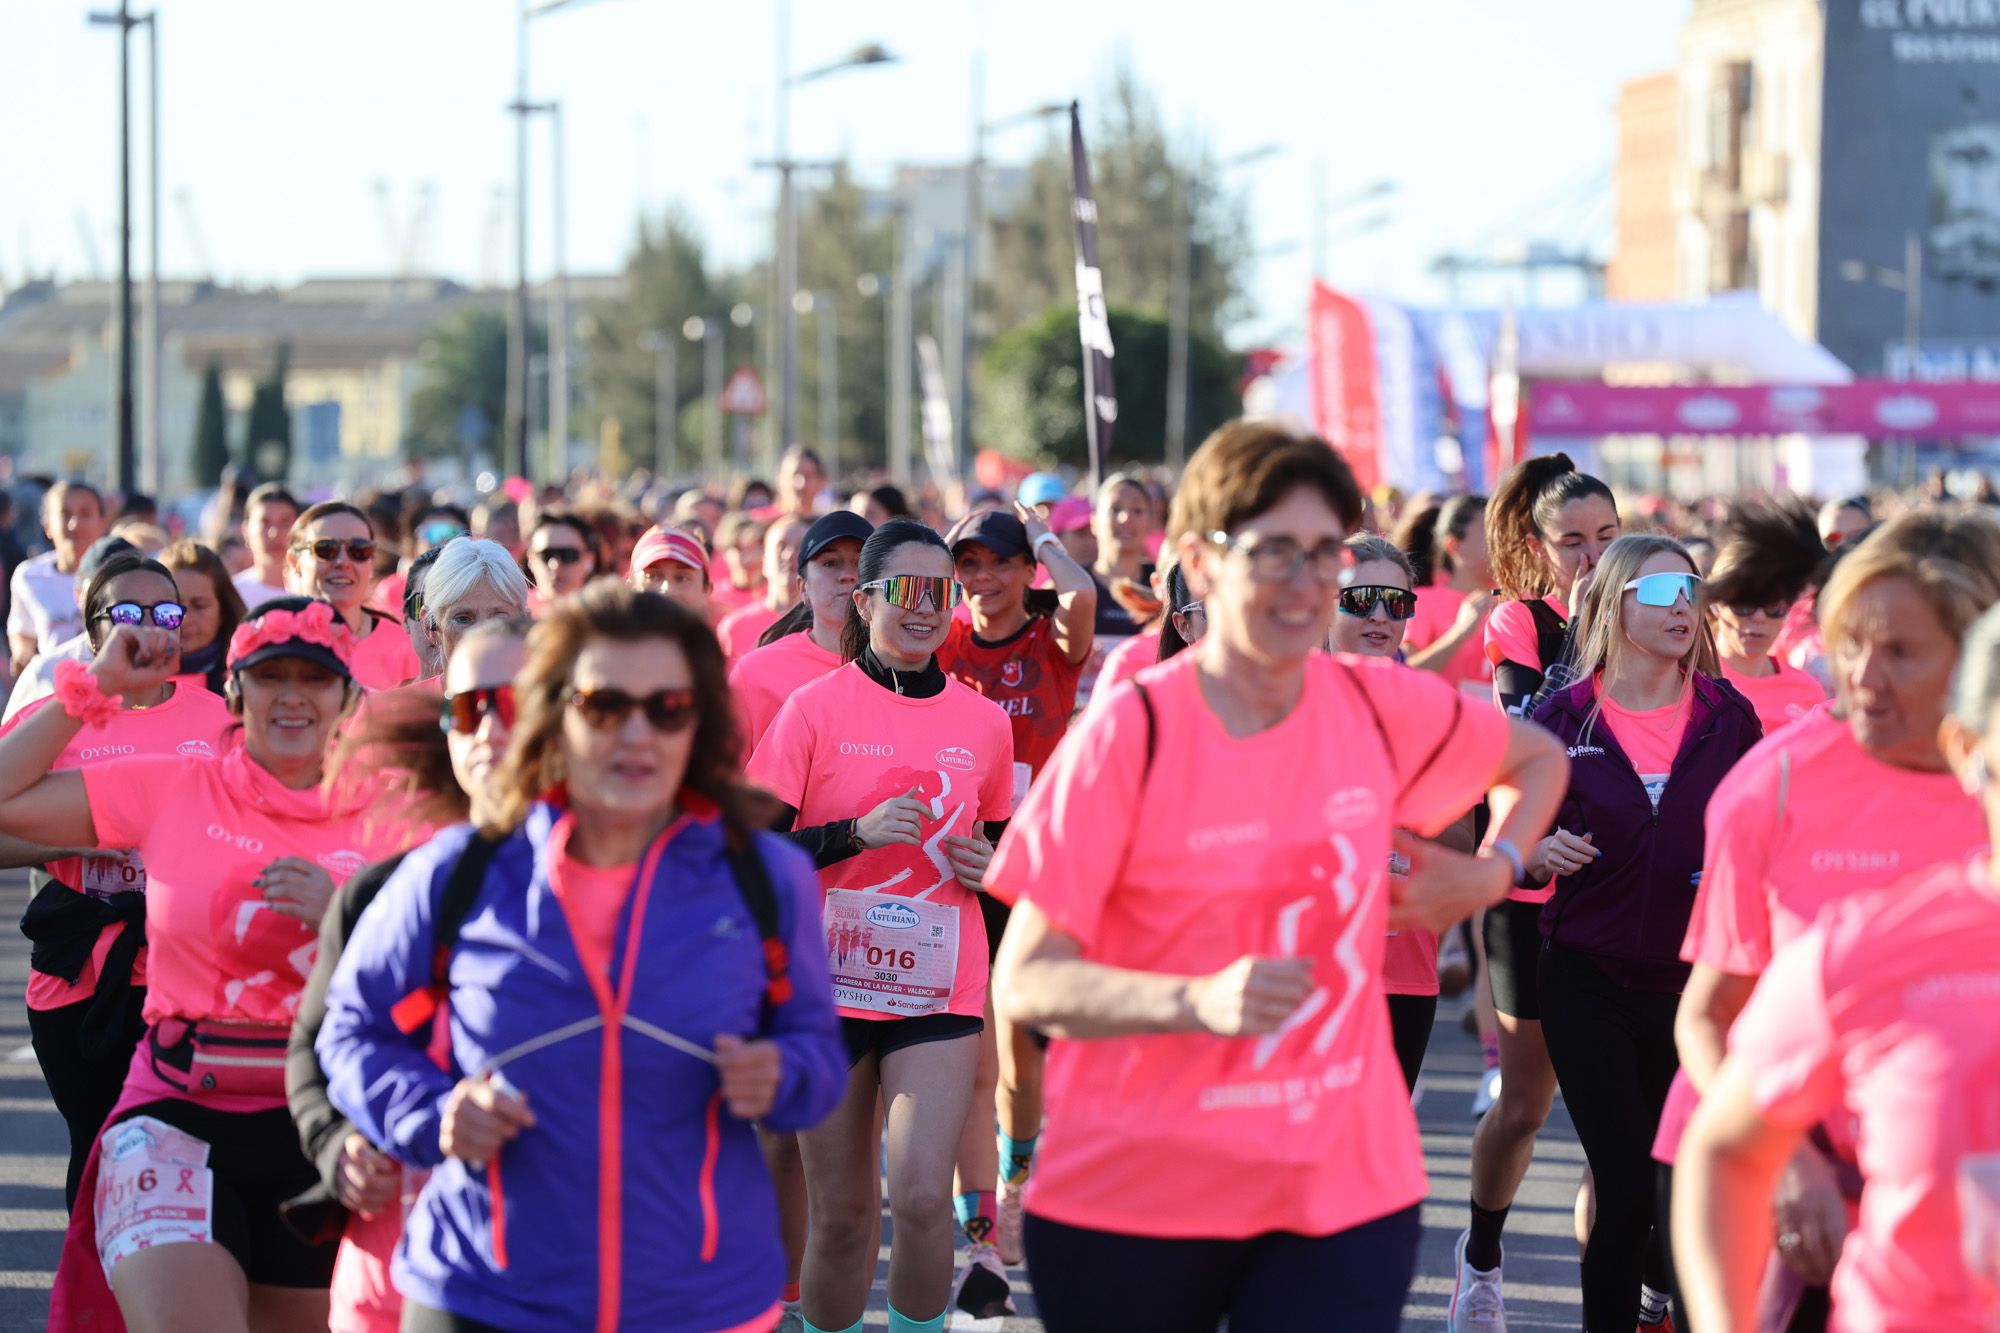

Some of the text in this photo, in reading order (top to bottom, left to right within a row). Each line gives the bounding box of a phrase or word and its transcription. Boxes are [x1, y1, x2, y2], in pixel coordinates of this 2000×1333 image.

[81, 745, 135, 760] OYSHO
[840, 742, 894, 757] OYSHO
[1577, 745, 1604, 753] Reece
[835, 910, 860, 920] SUMA
[870, 910, 916, 925] ASTURIANA
[867, 947, 915, 969] 016
[874, 971, 898, 982] 3030
[836, 976, 862, 987] CARRERA
[864, 980, 871, 988] DE
[873, 981, 880, 990] LA
[882, 983, 902, 993] MUJER
[907, 986, 936, 996] VALENCIA
[833, 988, 873, 1003] OYSHO
[897, 1000, 935, 1010] Santander
